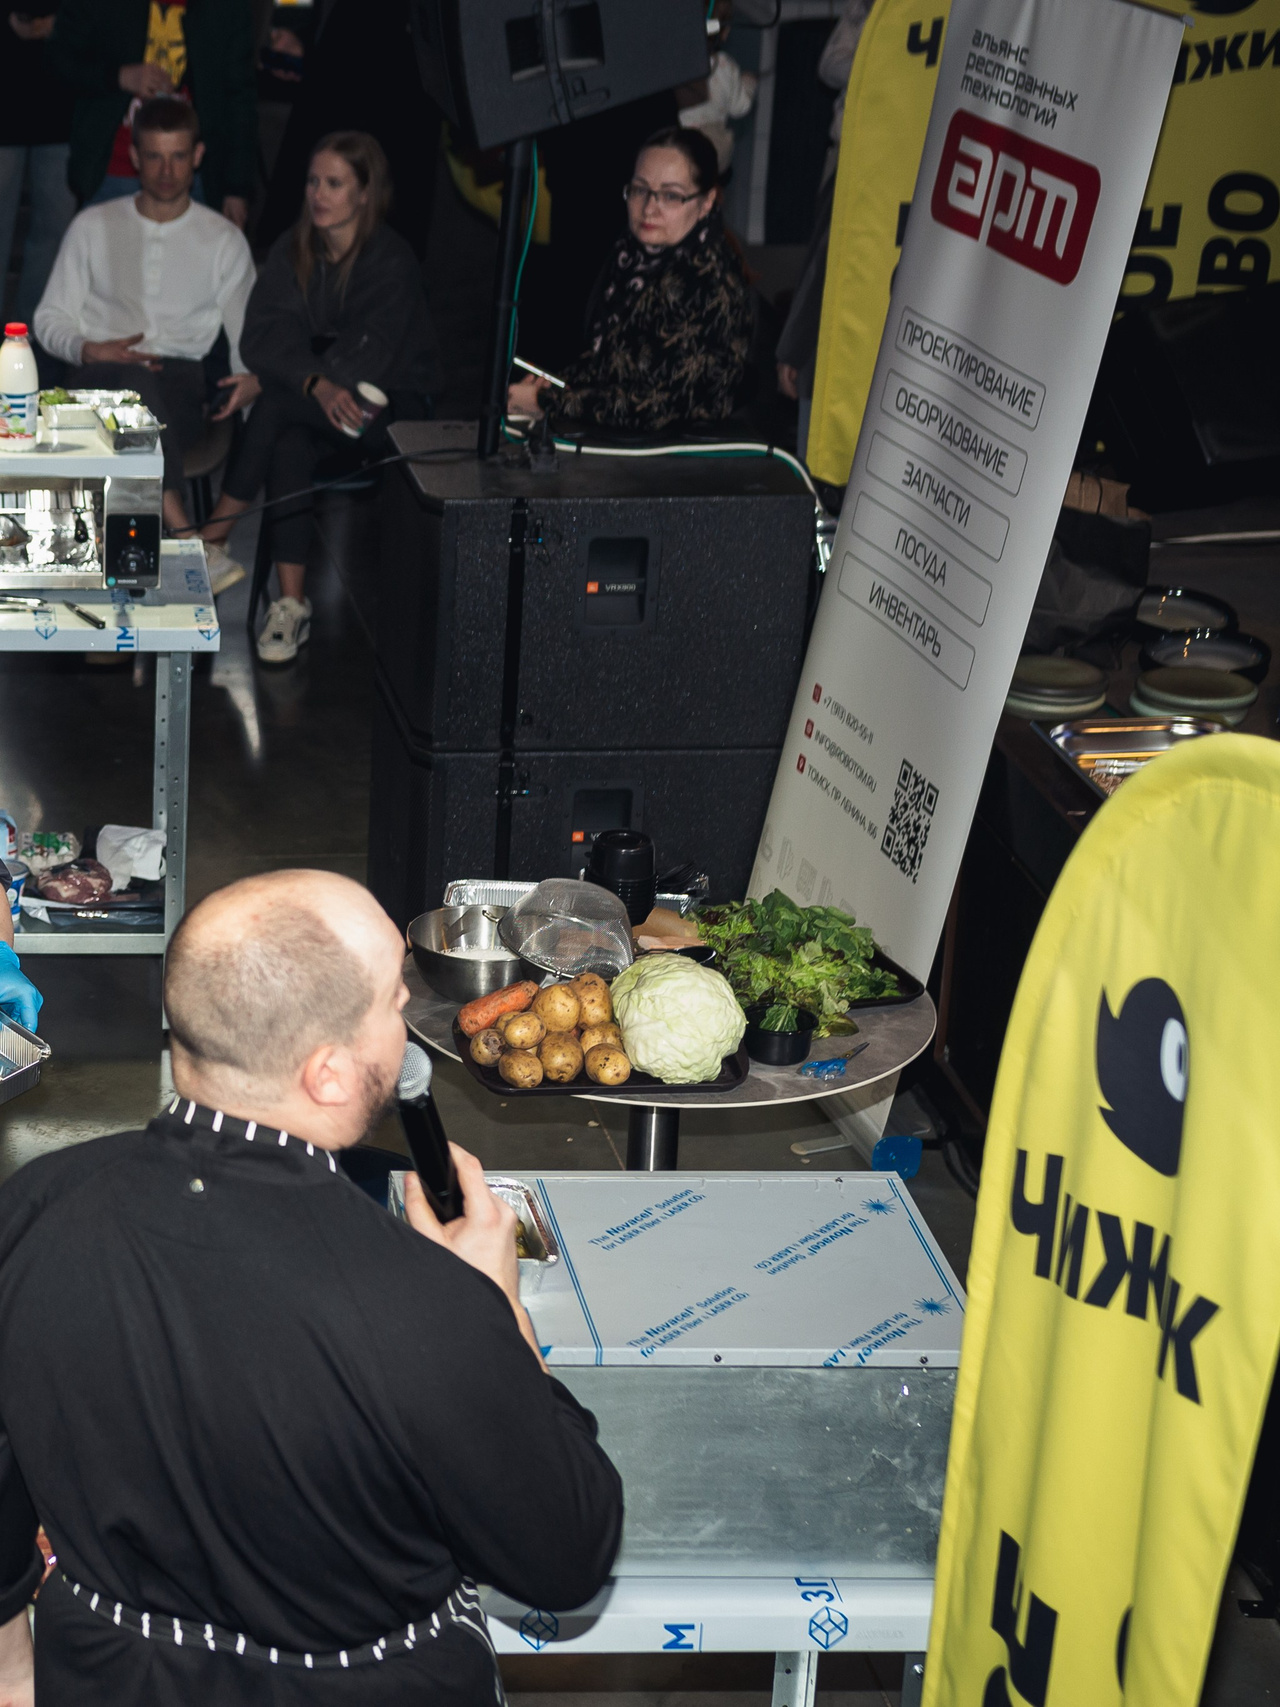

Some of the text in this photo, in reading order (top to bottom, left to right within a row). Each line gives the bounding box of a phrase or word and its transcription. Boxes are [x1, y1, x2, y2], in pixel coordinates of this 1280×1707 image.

[972, 28, 1029, 66] альянс
[961, 74, 1058, 130] технологий
[965, 51, 1079, 112] ресторанных
[903, 319, 1036, 418] ПРОЕКТИРОВАНИЕ
[895, 387, 1009, 478] ОБОРУДОВАНИЕ
[902, 460, 971, 528] ЗАПЧАСТИ
[895, 528, 947, 587] ПОСУДА
[869, 581, 941, 658] ИНВЕНТАРЬ
[588, 1235, 609, 1246] The
[655, 1189, 694, 1209] Solution
[601, 1242, 617, 1251] for
[614, 1228, 640, 1245] LASER
[639, 1218, 661, 1232] Fiber
[664, 1201, 690, 1217] LASER
[798, 1231, 821, 1245] Fiber
[818, 1218, 844, 1234] LASER
[767, 1253, 807, 1275] Solution
[770, 1245, 797, 1262] LASER
[1011, 1147, 1222, 1407] ЧИЖК
[626, 1336, 649, 1348] The
[696, 1286, 736, 1308] Solution
[640, 1344, 656, 1359] for
[654, 1330, 682, 1347] LASER
[680, 1318, 703, 1332] Fiber
[705, 1300, 734, 1317] LASER
[848, 1333, 871, 1348] Fiber
[869, 1319, 896, 1335] LASER
